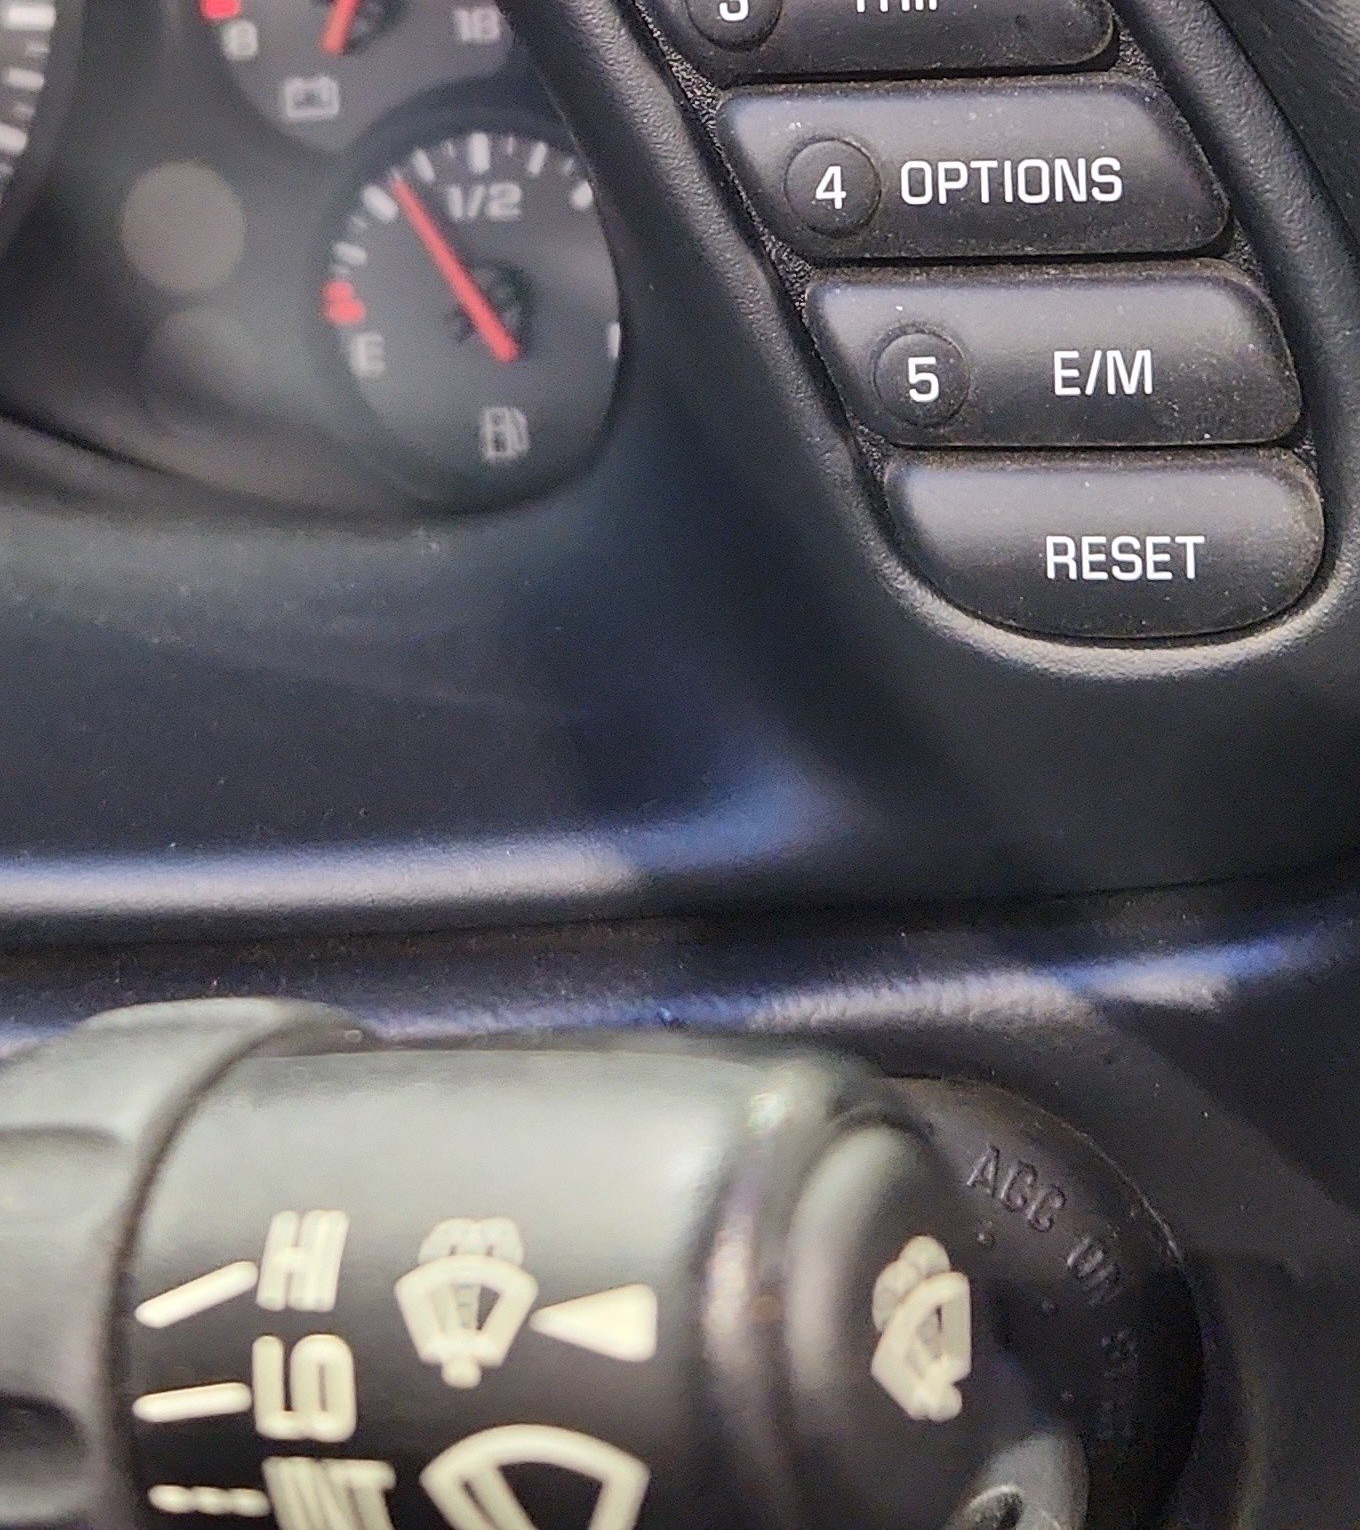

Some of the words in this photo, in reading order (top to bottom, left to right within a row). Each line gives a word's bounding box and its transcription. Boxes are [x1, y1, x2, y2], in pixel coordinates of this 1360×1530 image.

[444, 180, 524, 221] 1/2
[813, 164, 848, 210] 4
[898, 155, 1124, 206] OPTIONS
[347, 330, 387, 374] E
[905, 354, 941, 404] 5
[1051, 348, 1154, 397] E/M
[1043, 533, 1208, 582] RESET
[255, 1208, 351, 1313] HI
